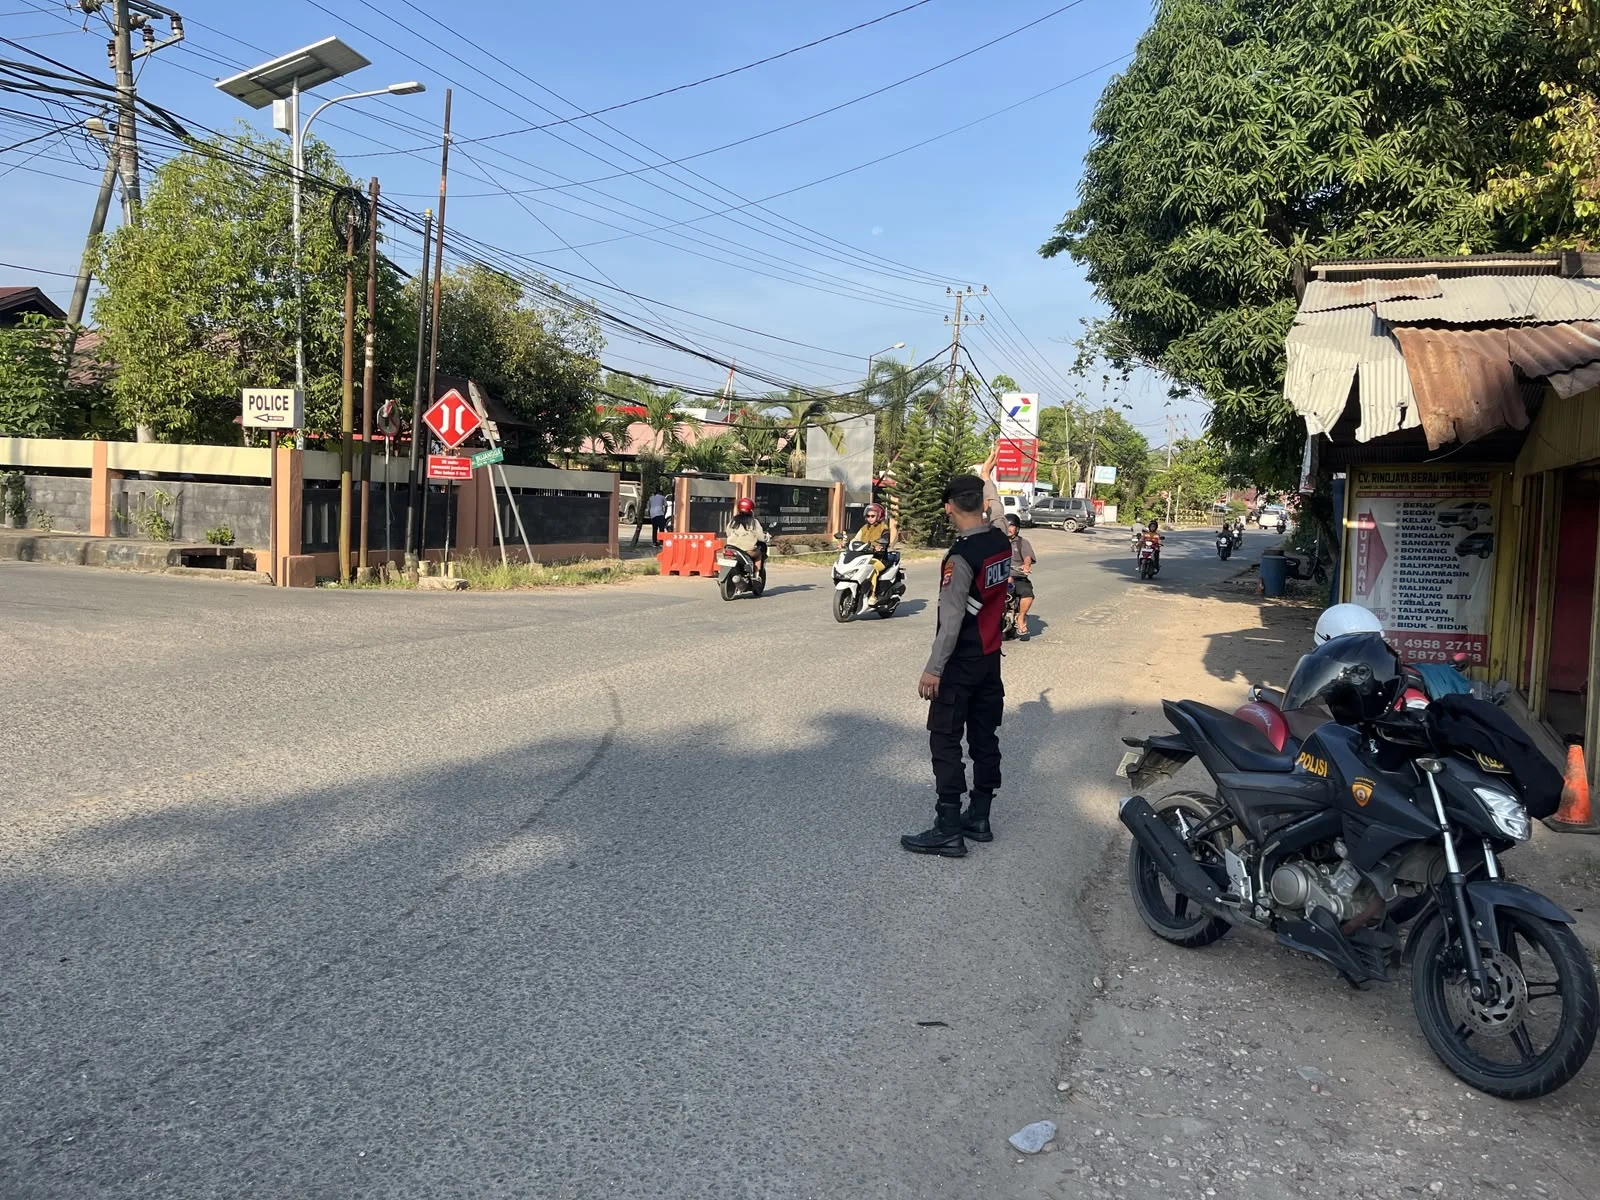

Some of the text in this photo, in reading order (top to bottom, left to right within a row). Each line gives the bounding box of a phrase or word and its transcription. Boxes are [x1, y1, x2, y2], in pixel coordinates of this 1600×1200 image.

[248, 395, 289, 411] POLICE
[1398, 592, 1444, 600] TANJUNG
[1425, 615, 1455, 623] PUTIH
[1404, 639, 1440, 649] 4958
[1445, 641, 1482, 651] 2715
[1407, 650, 1446, 660] 5879
[1295, 752, 1328, 778] POLISI
